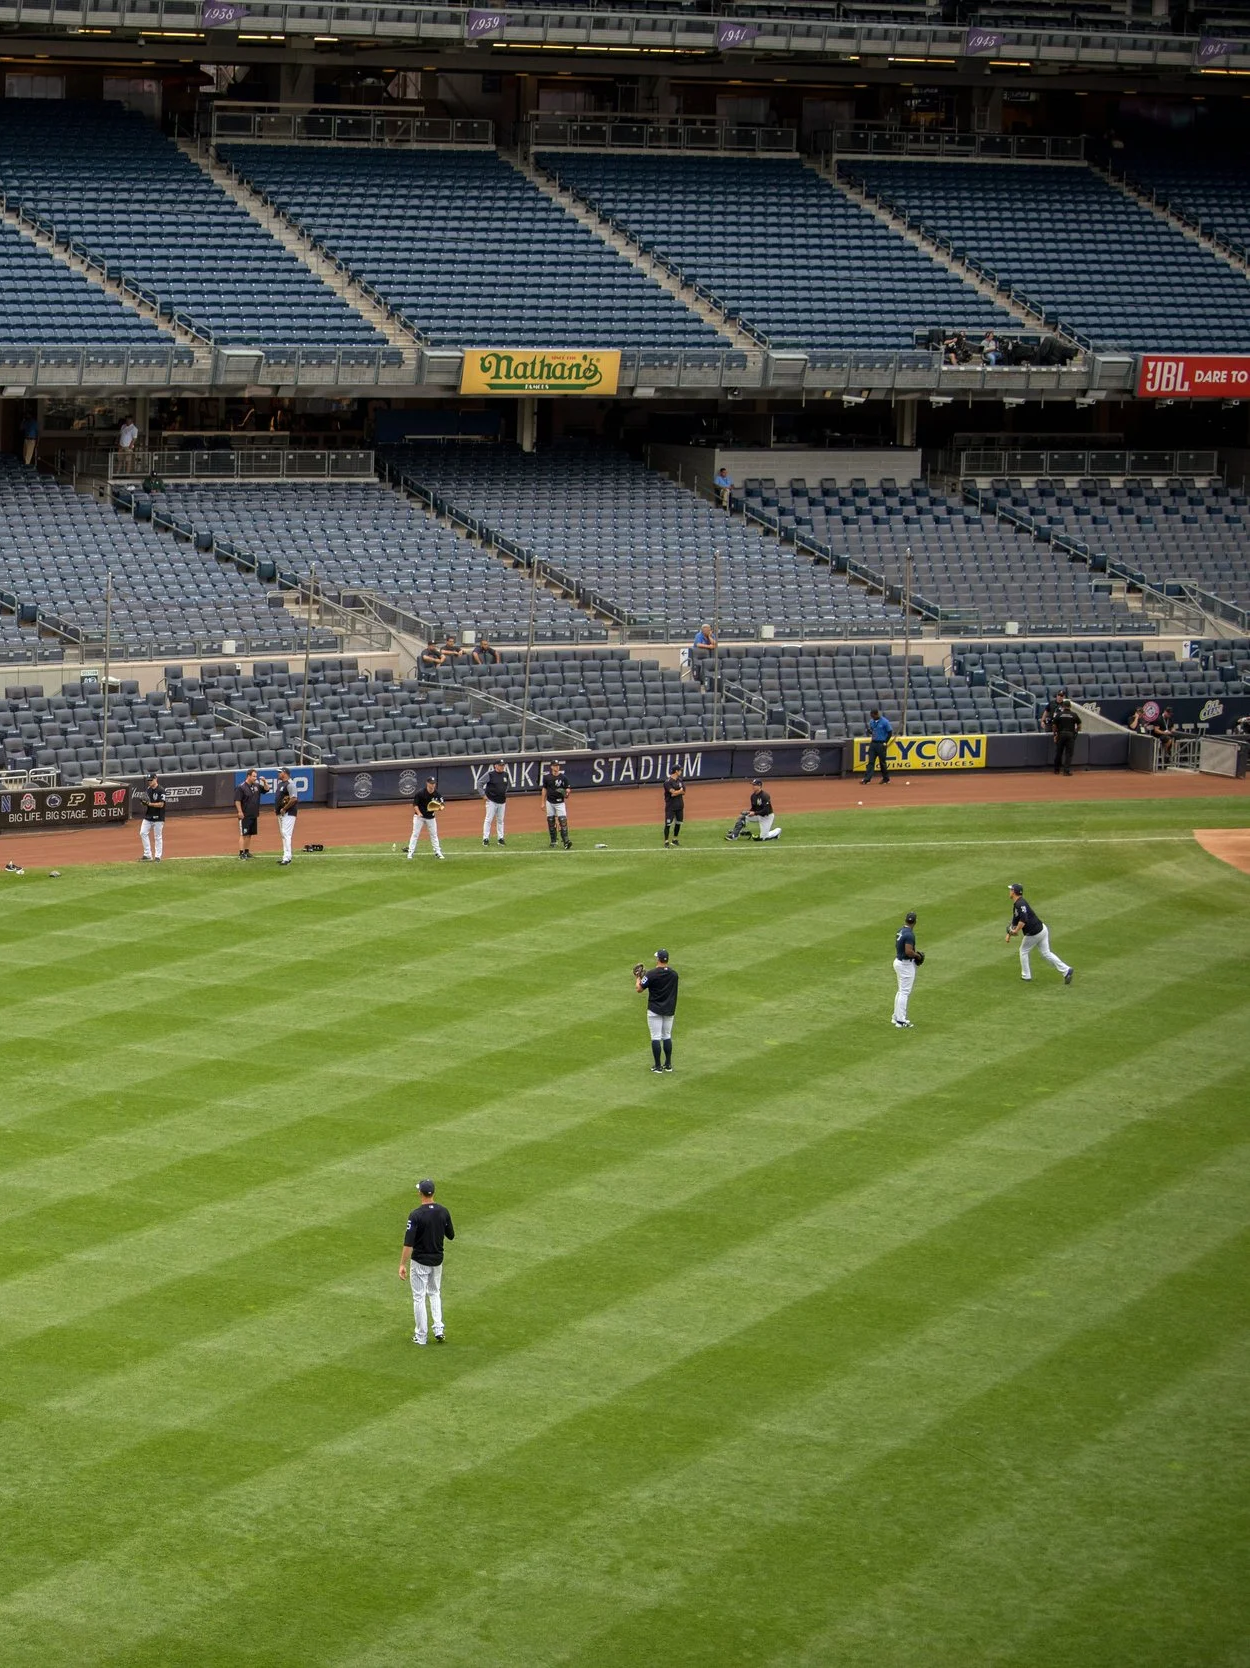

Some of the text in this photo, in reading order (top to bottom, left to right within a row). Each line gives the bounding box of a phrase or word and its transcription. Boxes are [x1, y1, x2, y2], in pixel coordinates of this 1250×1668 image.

[205, 8, 235, 20] 1938
[470, 17, 500, 31] 1939
[720, 28, 747, 42] 1941
[1145, 361, 1249, 392] JBL DARE TO
[592, 752, 702, 783] STADIUM
[920, 760, 974, 768] SERVICES
[93, 791, 107, 805] R
[165, 787, 203, 796] STEINER
[8, 813, 23, 822] BIG
[24, 811, 43, 822] LIFE.
[45, 811, 59, 821] BIG
[60, 809, 88, 820] STAGE.
[92, 808, 106, 818] BIG
